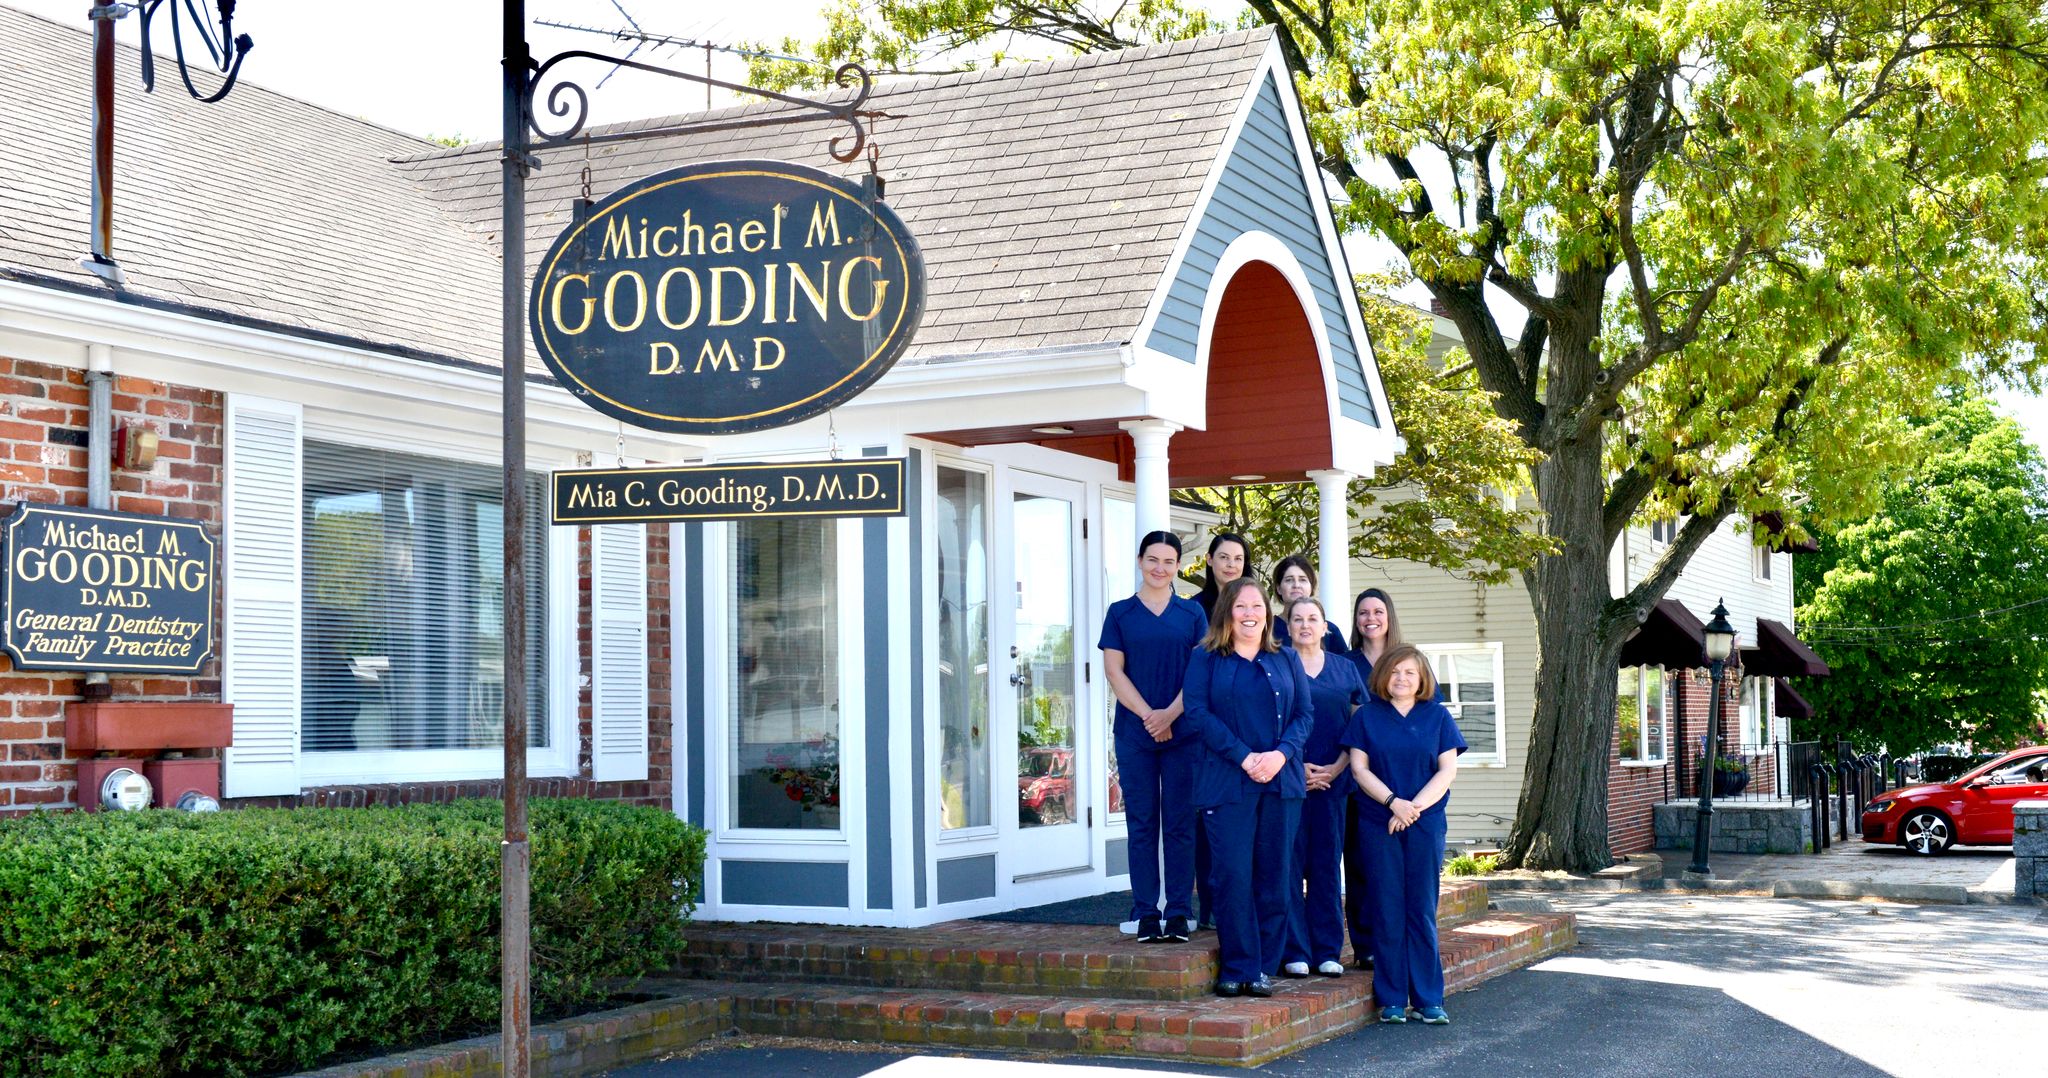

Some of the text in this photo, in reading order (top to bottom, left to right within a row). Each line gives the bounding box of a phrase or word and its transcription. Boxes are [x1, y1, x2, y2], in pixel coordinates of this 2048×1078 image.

[599, 199, 854, 260] Michael M.
[552, 256, 890, 335] GOODING
[567, 472, 887, 511] Mia C. Gooding, D.M.D.
[43, 520, 187, 557] Michael M.
[17, 547, 208, 592] GOODING
[80, 588, 151, 608] D.M.D.
[16, 608, 203, 640] General Dentistry
[23, 632, 192, 660] Family Practice
